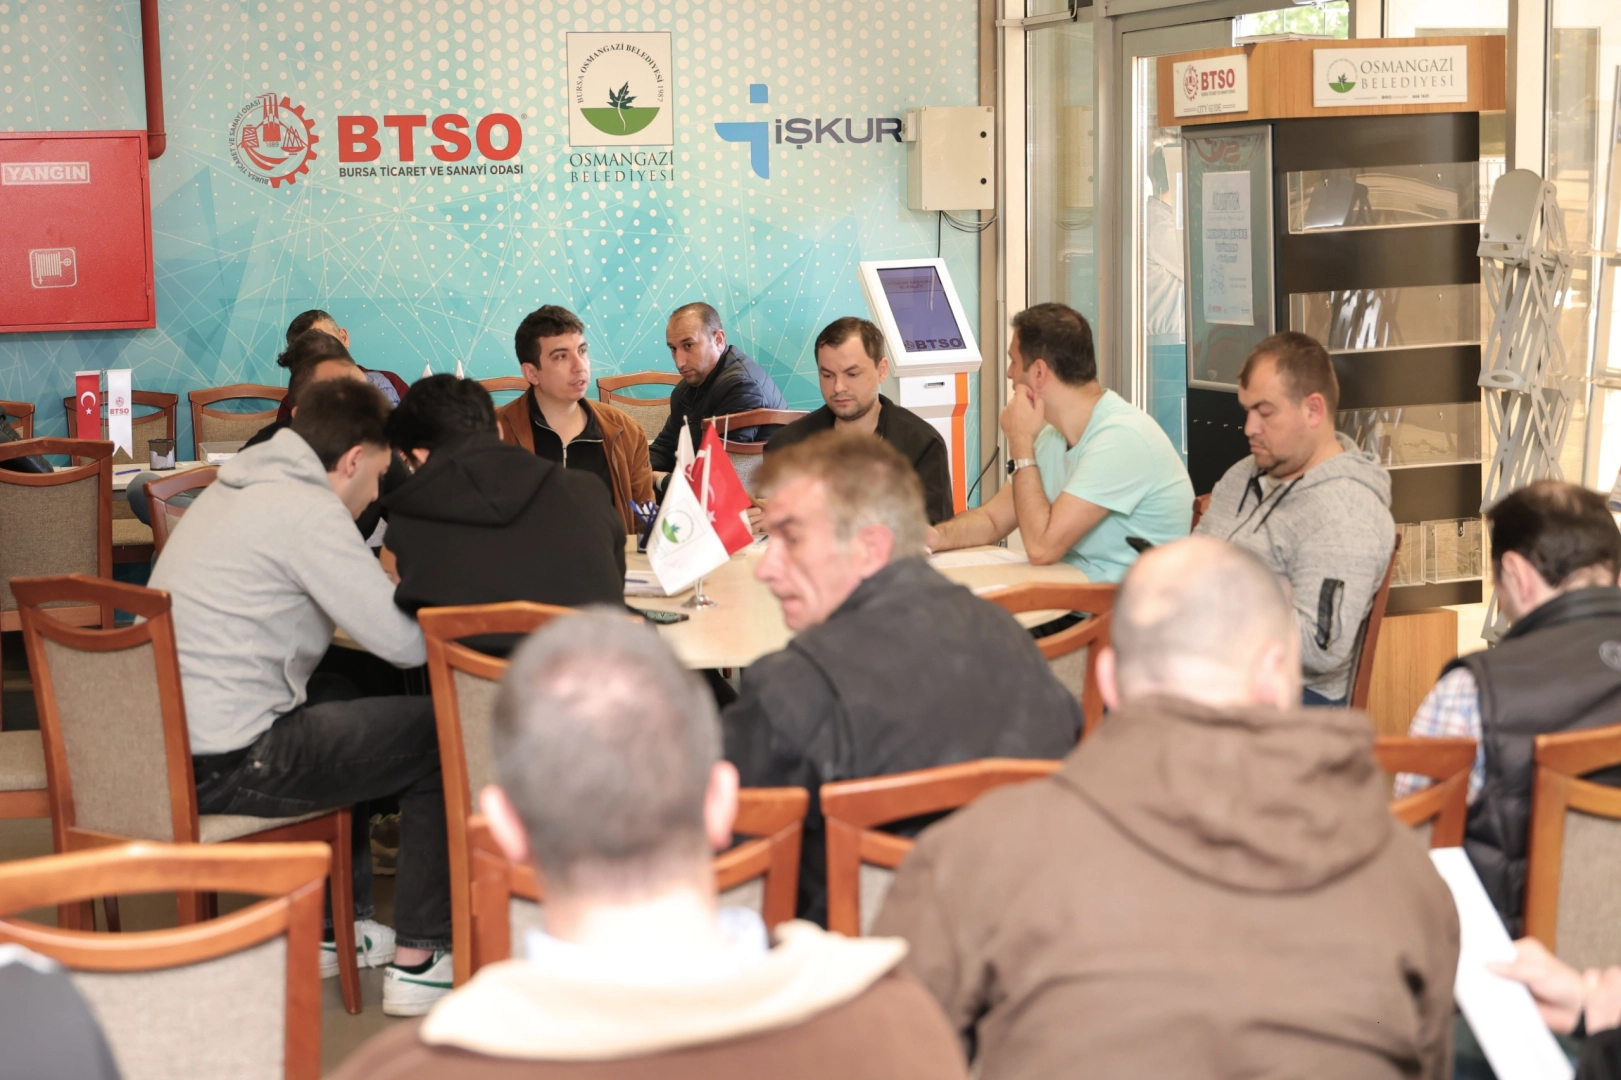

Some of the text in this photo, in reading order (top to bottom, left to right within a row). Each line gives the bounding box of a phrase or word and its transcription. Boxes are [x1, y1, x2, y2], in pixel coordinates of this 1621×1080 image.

[576, 75, 584, 103] BURSA
[580, 42, 624, 73] OSMANGAZİ
[626, 44, 664, 83] BELEDİYESİ
[1360, 56, 1454, 74] OSMANGAZİ
[1201, 68, 1235, 91] BTSO
[1361, 74, 1454, 89] BELEDİYESİ
[229, 100, 269, 184] BURSA TİCARET VE SANAYİ ODASI
[337, 113, 522, 162] BTSO
[569, 150, 674, 167] OSMANGAZİ
[6, 165, 86, 181] YANGIN
[339, 164, 524, 177] BURSA TİCARET VE SANAYİ ODASI
[571, 168, 674, 183] BELEDİYESİ
[915, 337, 962, 350] BTSO
